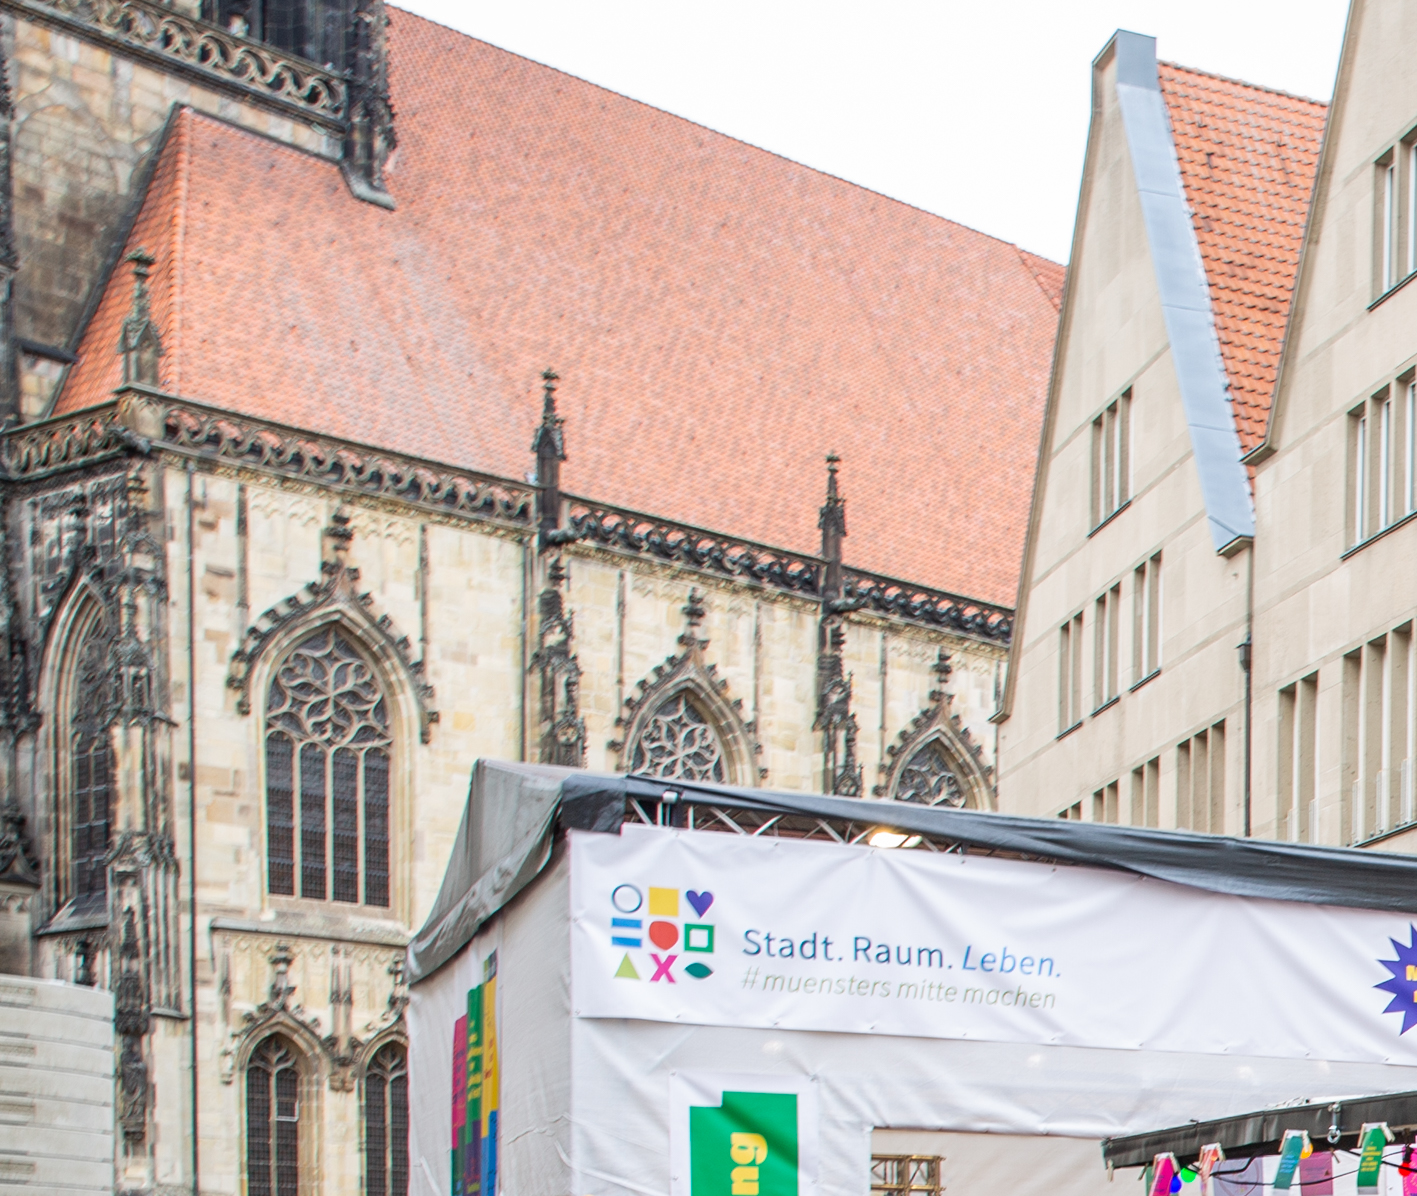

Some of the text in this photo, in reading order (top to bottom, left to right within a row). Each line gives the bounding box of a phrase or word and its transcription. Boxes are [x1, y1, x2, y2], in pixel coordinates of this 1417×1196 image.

[743, 928, 1062, 978] Stadt. Raum. Leben.
